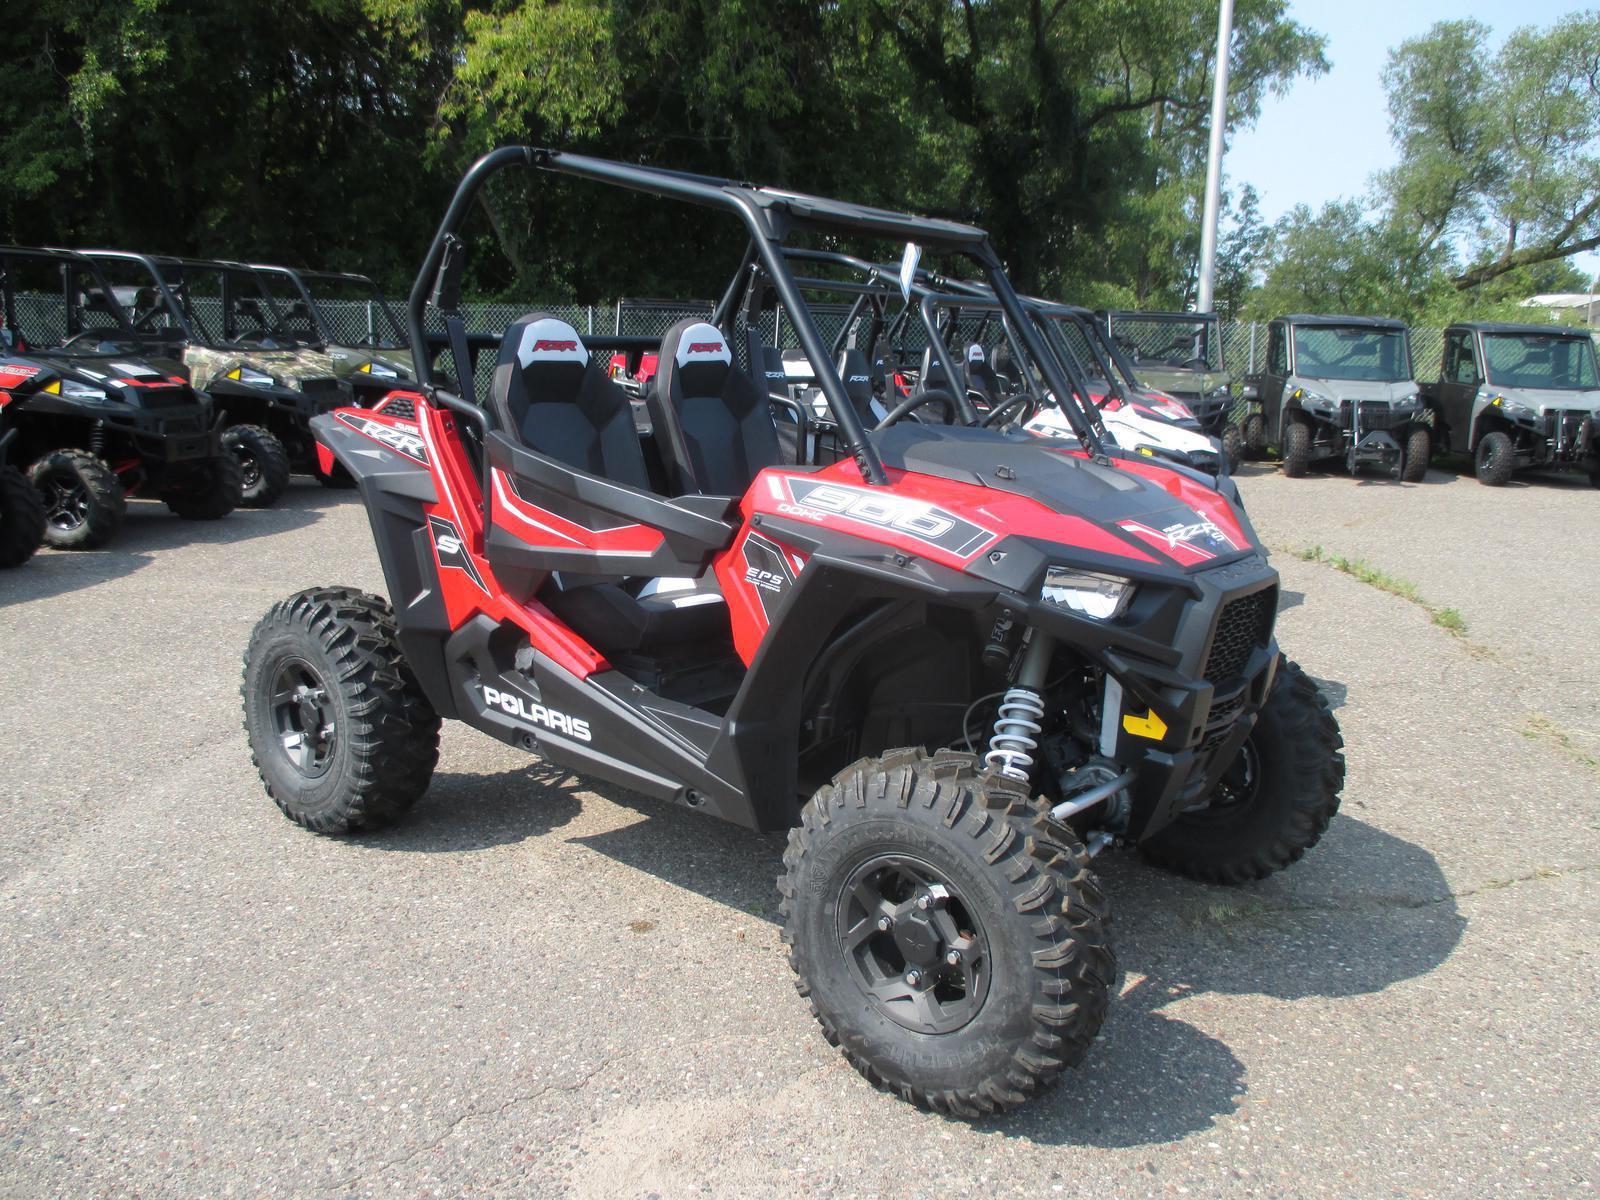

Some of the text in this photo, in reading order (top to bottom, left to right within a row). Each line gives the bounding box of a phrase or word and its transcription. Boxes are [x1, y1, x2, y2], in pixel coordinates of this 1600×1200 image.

[362, 420, 426, 459] RZR
[777, 504, 826, 522] DOHC
[437, 534, 464, 554] S
[747, 567, 784, 585] EPS
[483, 685, 592, 741] POLARIS
